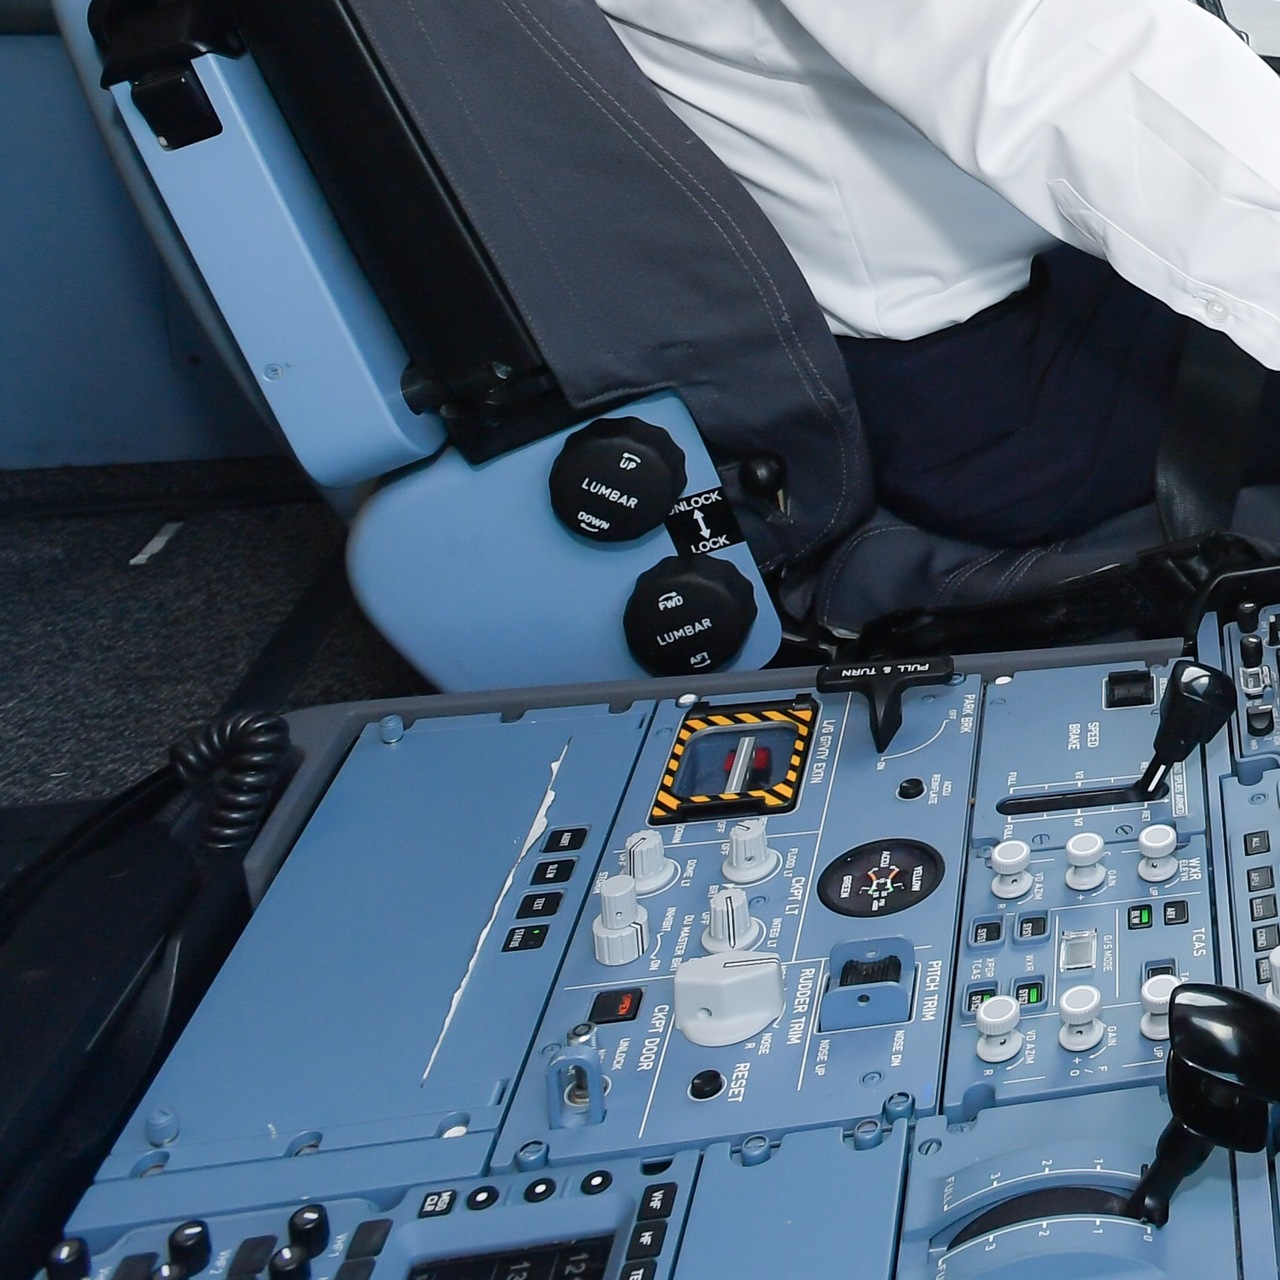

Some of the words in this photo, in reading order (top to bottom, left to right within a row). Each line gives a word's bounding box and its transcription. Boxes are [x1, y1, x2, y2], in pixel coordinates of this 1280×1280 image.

[619, 458, 638, 470] UP
[582, 478, 638, 509] LUMBAR
[577, 511, 610, 530] DOWN
[690, 534, 730, 554] LOCK
[658, 596, 684, 611] FWD
[656, 618, 712, 646] LUMBAR
[690, 652, 710, 664] AFT
[897, 664, 930, 672] PULL
[842, 667, 876, 676] TURN
[963, 695, 975, 717] PARK
[960, 717, 973, 733] BRK
[1068, 724, 1080, 750] BRAKE
[1087, 721, 1100, 748] SPEED
[1189, 857, 1202, 880] WXR
[1192, 927, 1206, 956] TCAS
[924, 960, 942, 990] PITCH
[795, 967, 815, 1014] RUDDER
[651, 1005, 669, 1033] CKPT
[922, 993, 938, 1021] TRIM
[787, 1016, 804, 1045] TRIM
[637, 1038, 661, 1071] DOOR
[727, 1062, 750, 1103] RESET
